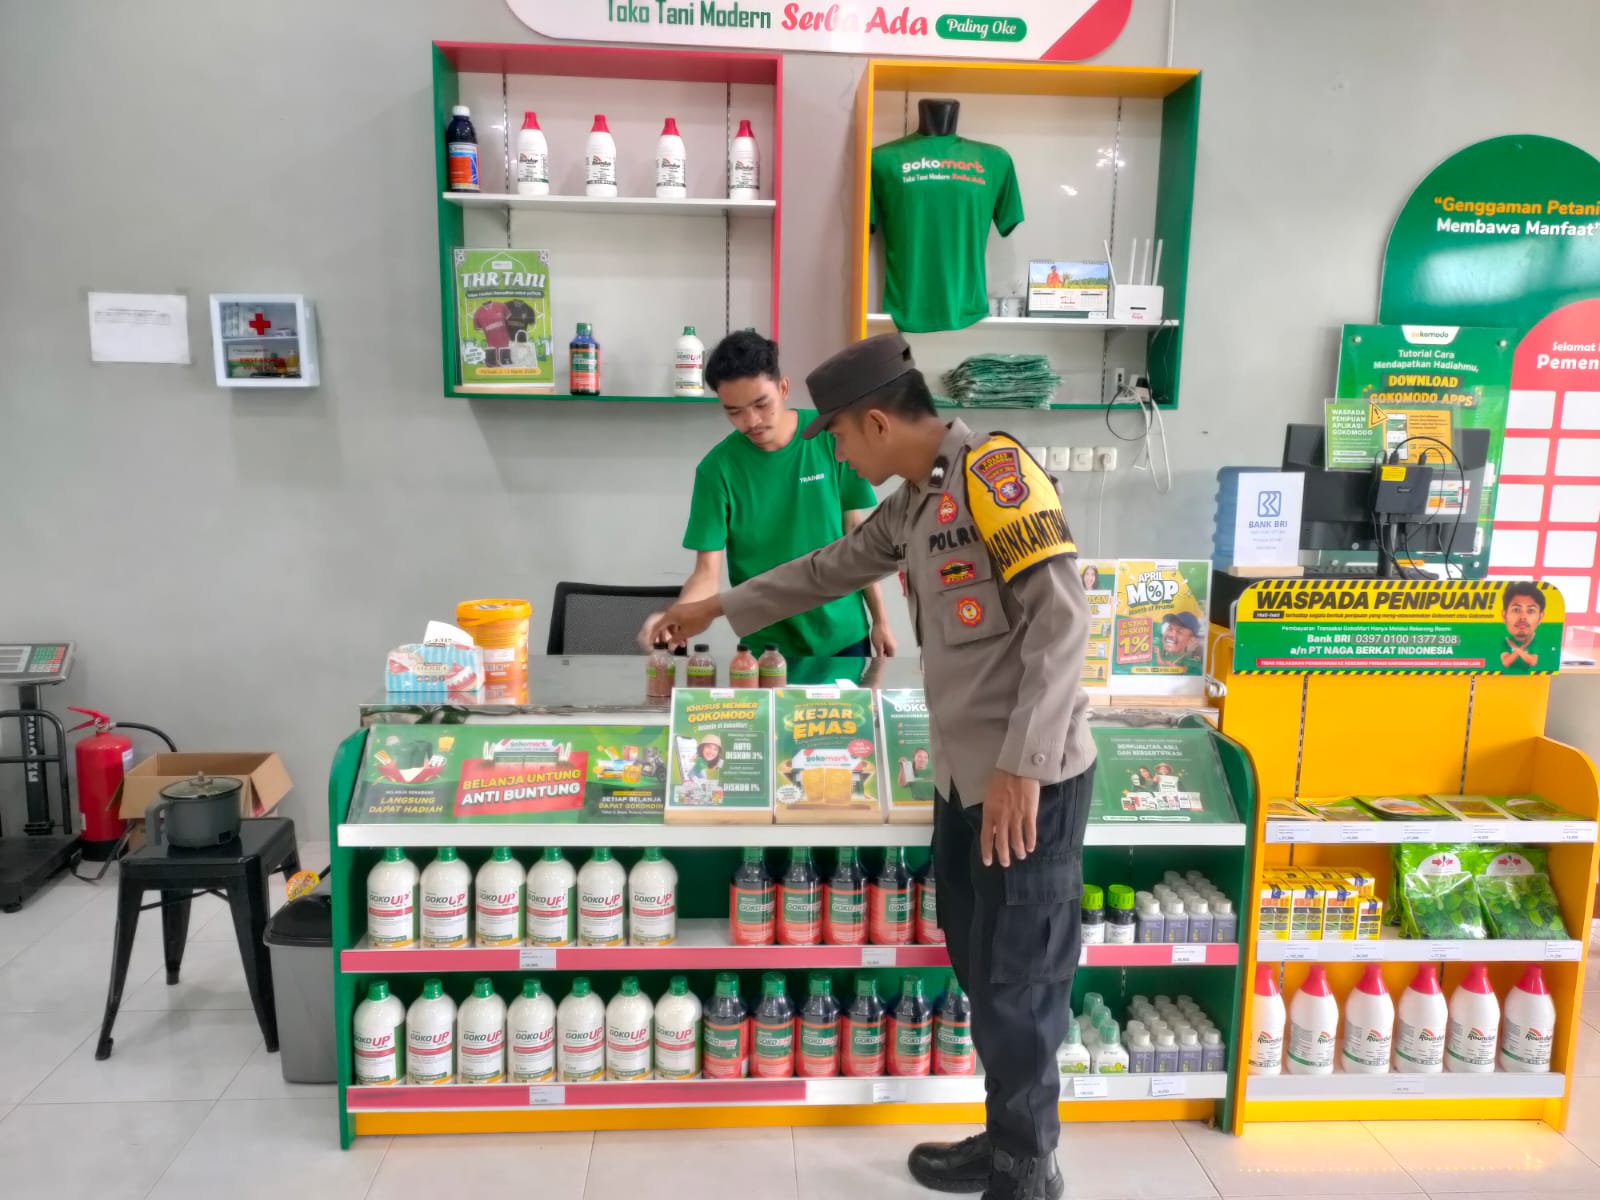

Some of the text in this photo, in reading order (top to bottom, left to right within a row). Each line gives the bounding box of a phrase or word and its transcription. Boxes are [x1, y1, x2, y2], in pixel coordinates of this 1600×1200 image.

[608, 0, 650, 23] Toko
[656, 0, 694, 25] Tani
[700, 1, 771, 29] Modern
[865, 6, 928, 36] Ada
[946, 18, 1017, 39] Paling Oke
[902, 157, 985, 174] gokomart
[1436, 217, 1520, 235] Membawa
[1552, 341, 1597, 352] Selamat
[1398, 349, 1455, 359] Tutorial Cara
[1373, 361, 1432, 370] Mendapatkan
[1388, 375, 1459, 388] DOWNLOAD
[1369, 393, 1474, 407] GOKOMODO APPS
[1248, 520, 1288, 529] BANK BRI
[928, 525, 980, 552] POLRI
[1256, 591, 1496, 610] WASPADA PENIPUAN!
[1307, 634, 1351, 643] Bank BRI
[1355, 635, 1458, 644] 0397 0100 1377 308
[1290, 646, 1454, 655] a/n PT NAGA BERKAT INDONESIA
[687, 711, 755, 723] GOKOMODO
[793, 708, 853, 722] KEJAR
[793, 720, 857, 740] EMAS
[733, 742, 752, 751] AUTO
[725, 752, 752, 760] DISKON
[463, 769, 581, 790] BELANJA UNTUNG
[723, 783, 750, 792] DISKON
[461, 782, 581, 806] ANTI BUNTUNG
[380, 797, 436, 805] LANGSUNG
[369, 805, 443, 814] DAPAT HADIAH
